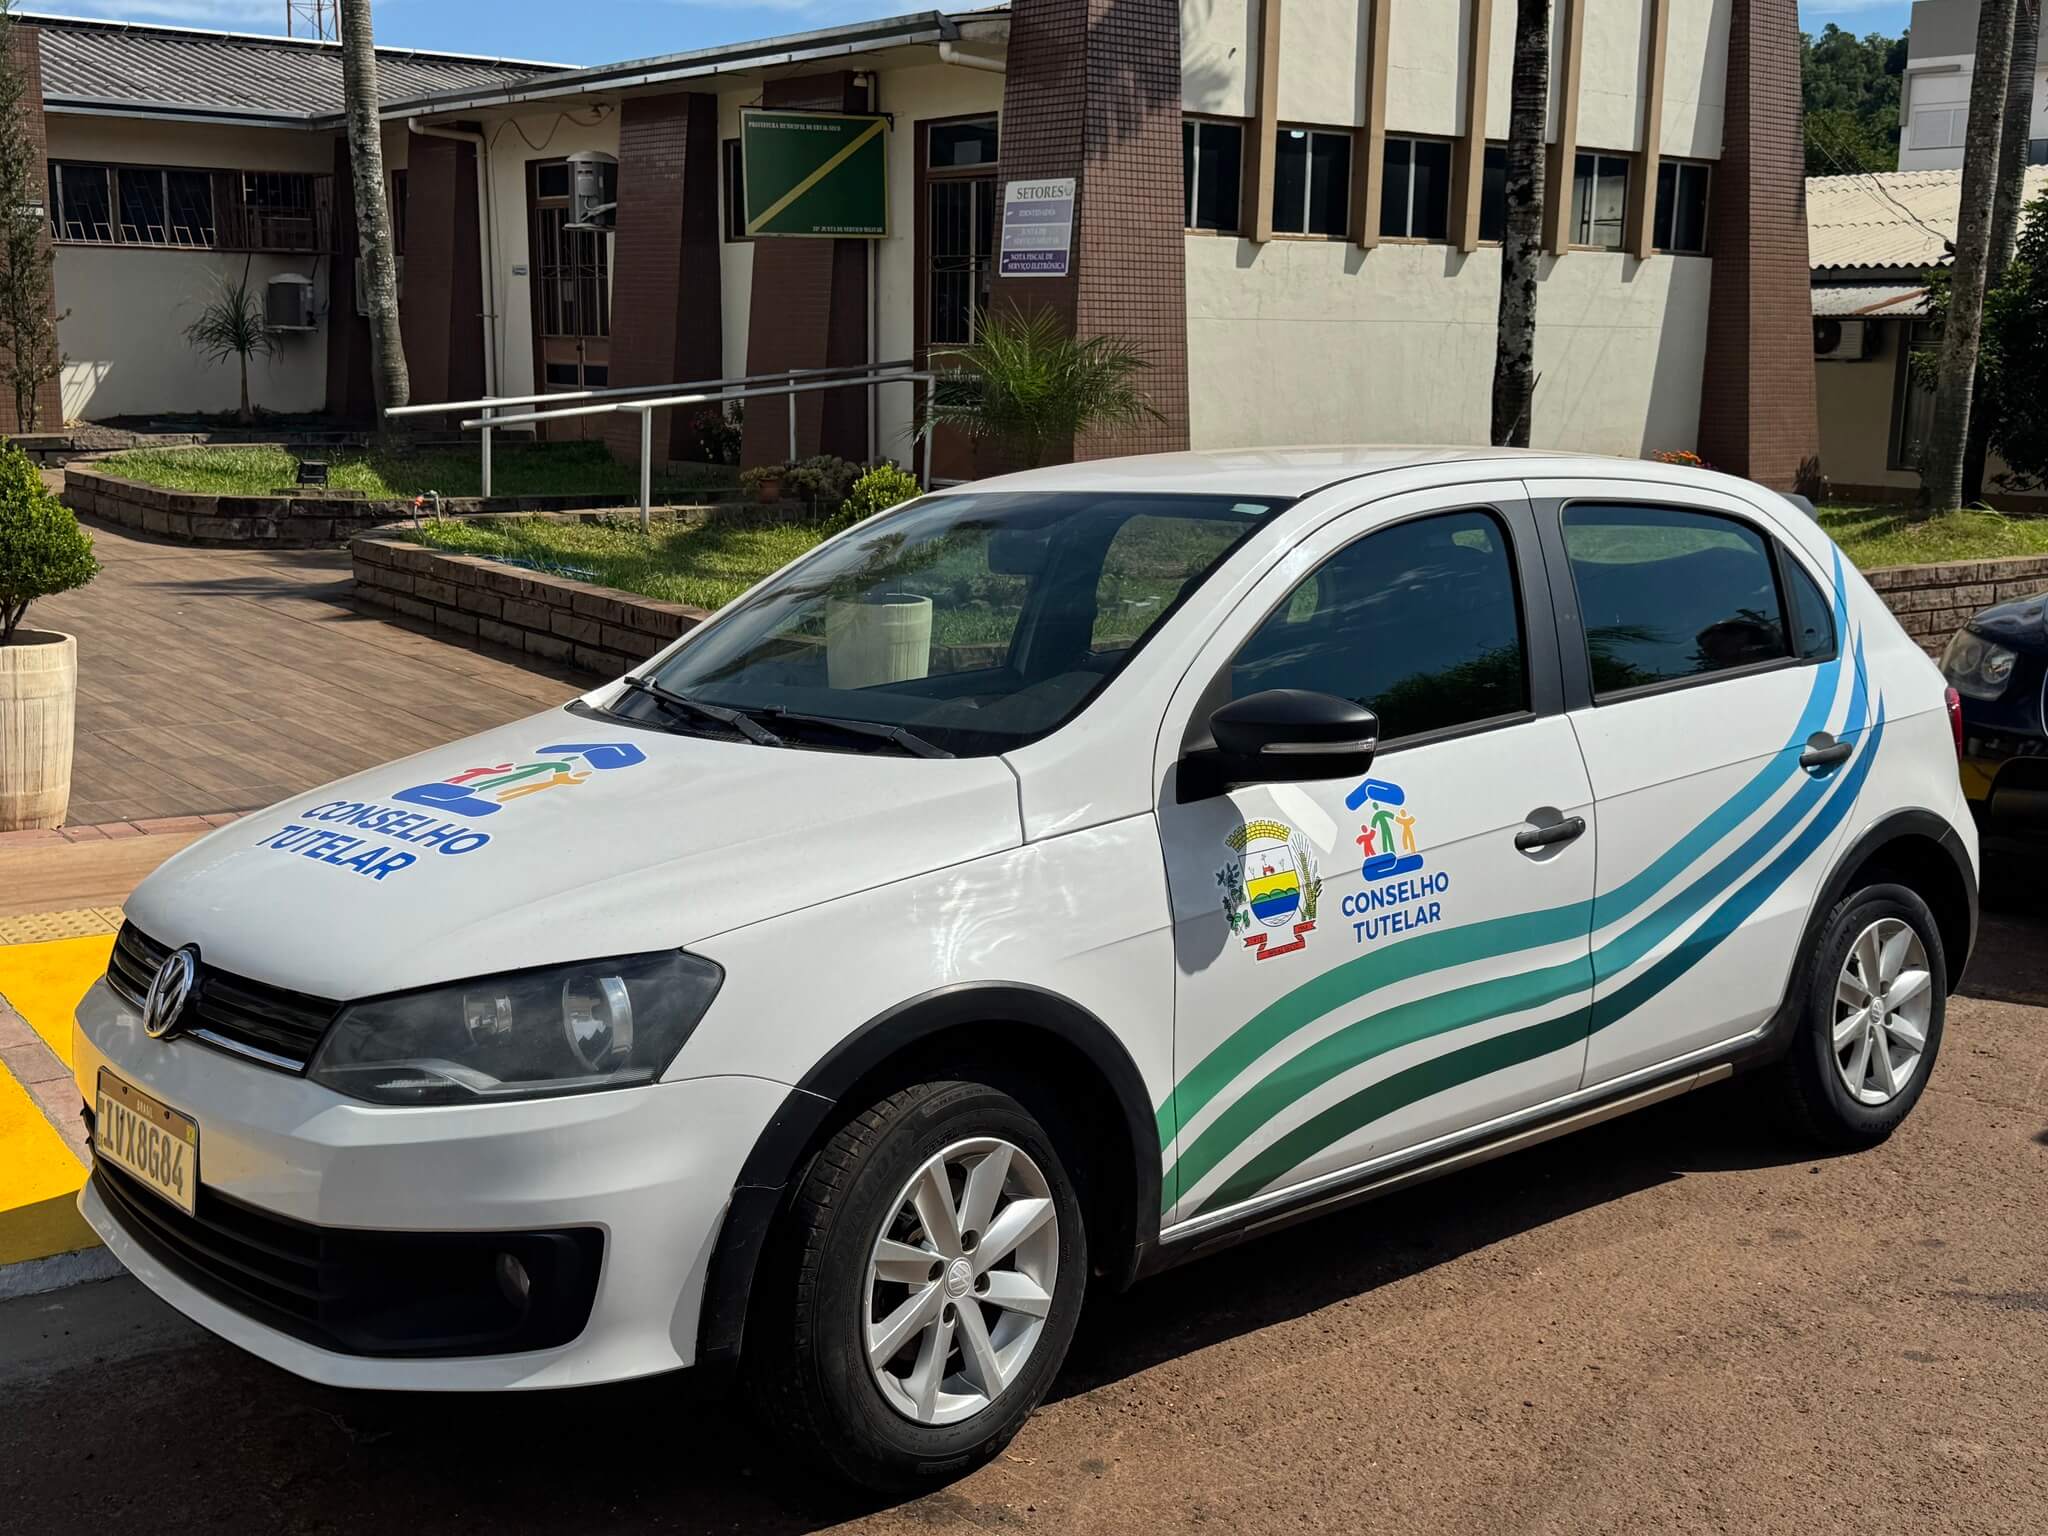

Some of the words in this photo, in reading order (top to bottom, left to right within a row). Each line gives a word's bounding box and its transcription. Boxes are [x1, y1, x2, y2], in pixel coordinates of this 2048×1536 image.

[1016, 185, 1064, 200] SETORES
[1008, 262, 1031, 270] SERVIÇO
[1026, 252, 1044, 260] FISCAL
[302, 801, 491, 855] CONSELHO
[255, 824, 417, 881] TUTELAR
[1341, 871, 1450, 917] CONSELHO
[1352, 901, 1442, 944] TUTELAR
[103, 1100, 184, 1196] IVX8G84
